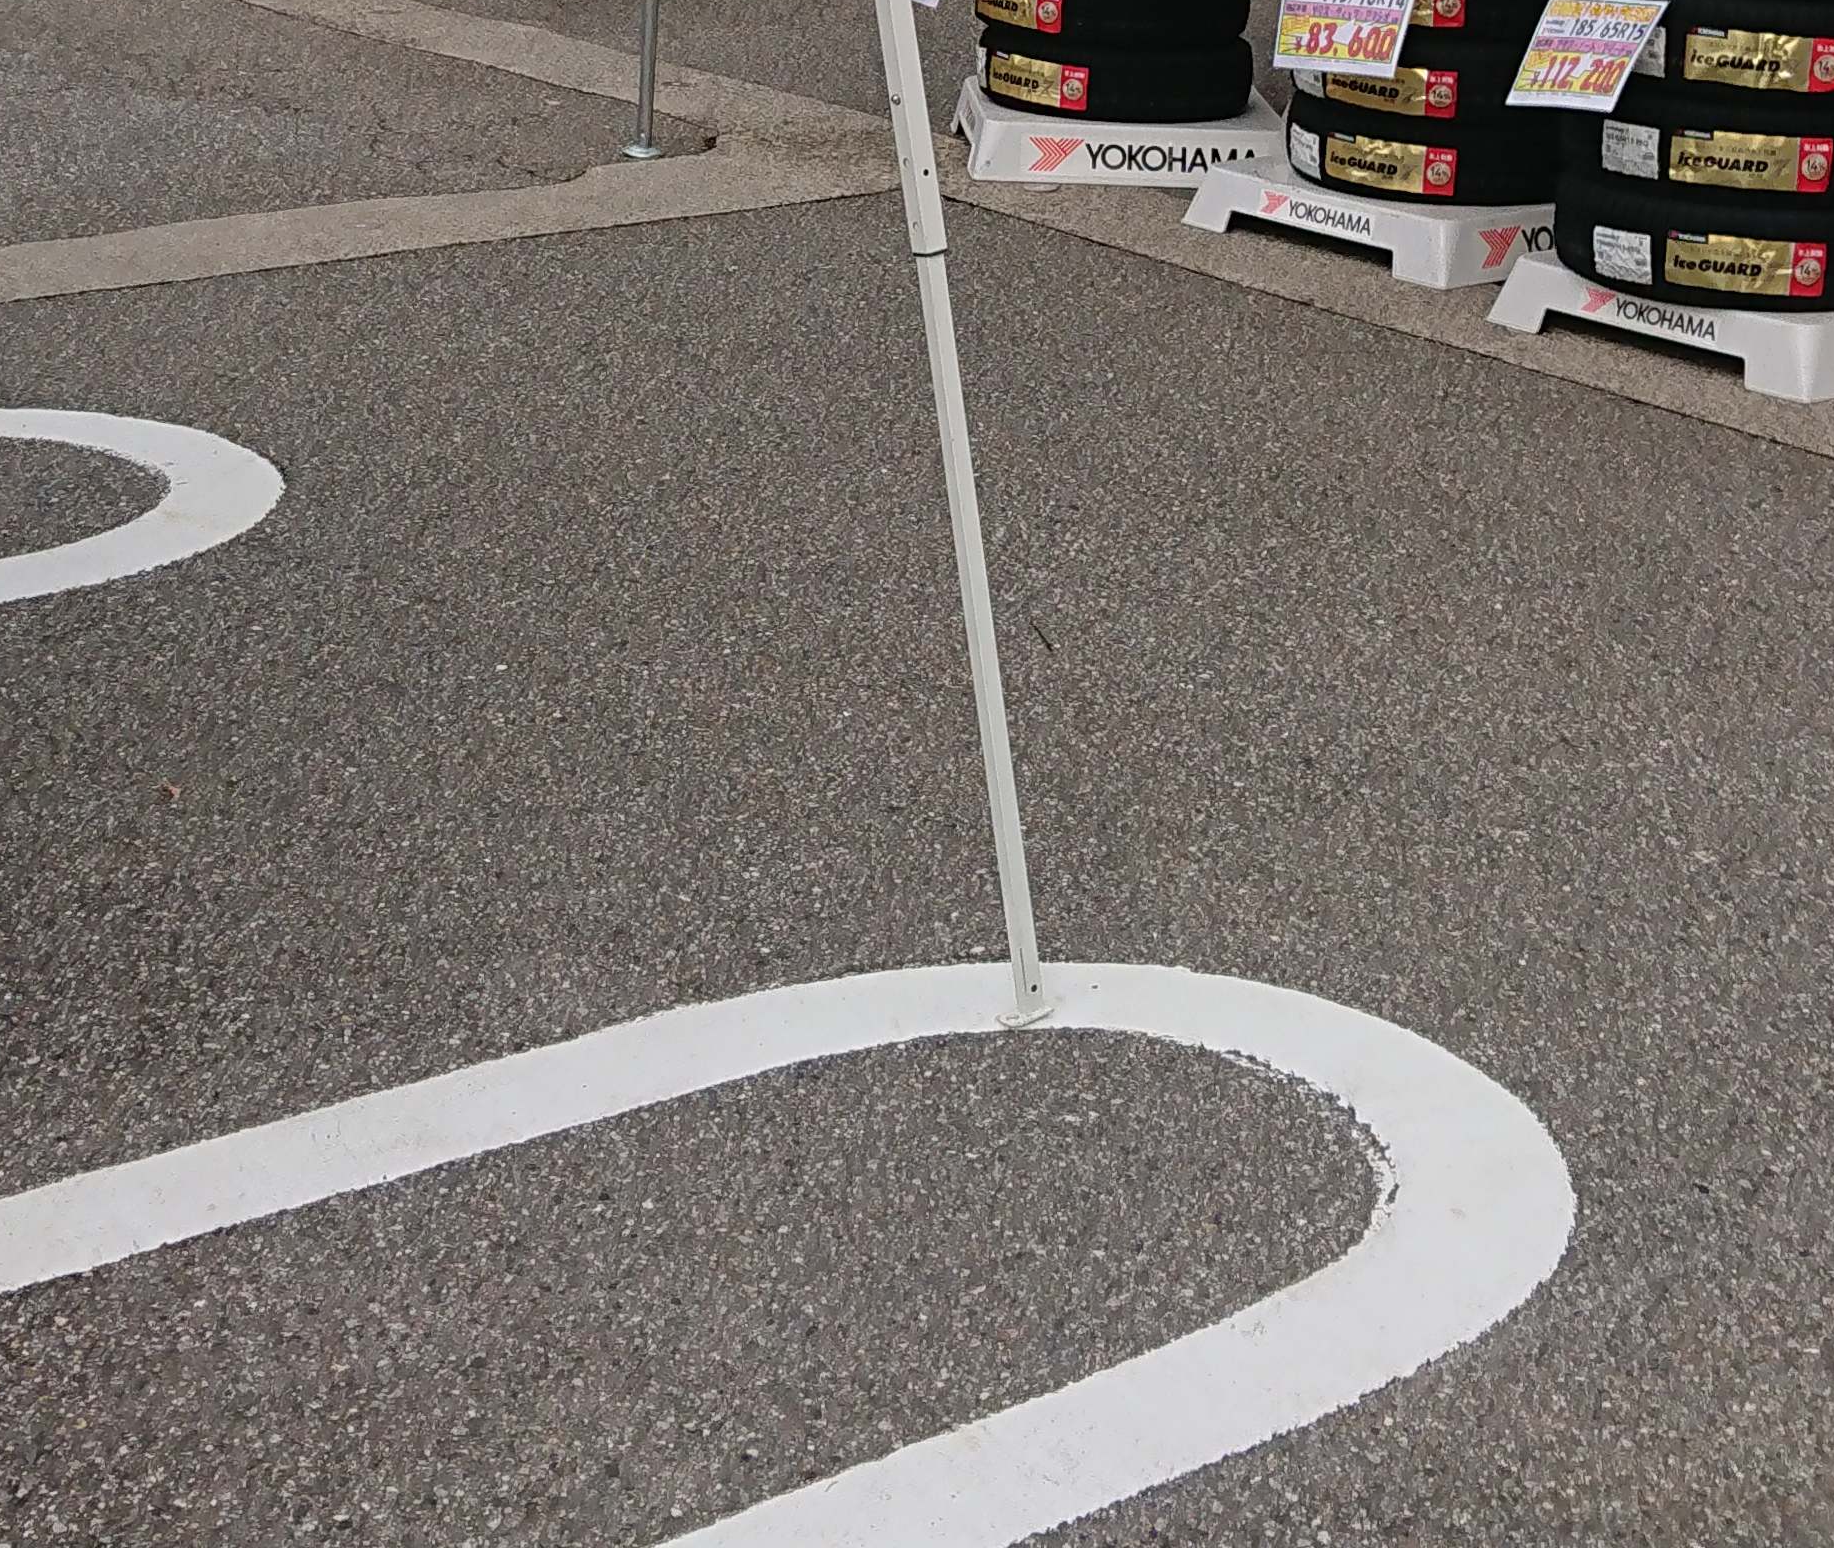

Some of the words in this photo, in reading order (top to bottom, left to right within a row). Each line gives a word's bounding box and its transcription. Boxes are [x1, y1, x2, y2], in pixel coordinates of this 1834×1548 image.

[1294, 20, 1398, 61] ¥83,600
[1569, 18, 1648, 42] 185/65R15
[1689, 49, 1781, 74] iceGUARD
[1329, 153, 1398, 176] iceGUARD
[1677, 150, 1769, 174] iceGUARD
[1289, 200, 1371, 237] YOKOHAMA
[1672, 254, 1763, 277] iceGUARD
[1613, 296, 1718, 342] YOKOHAMA
